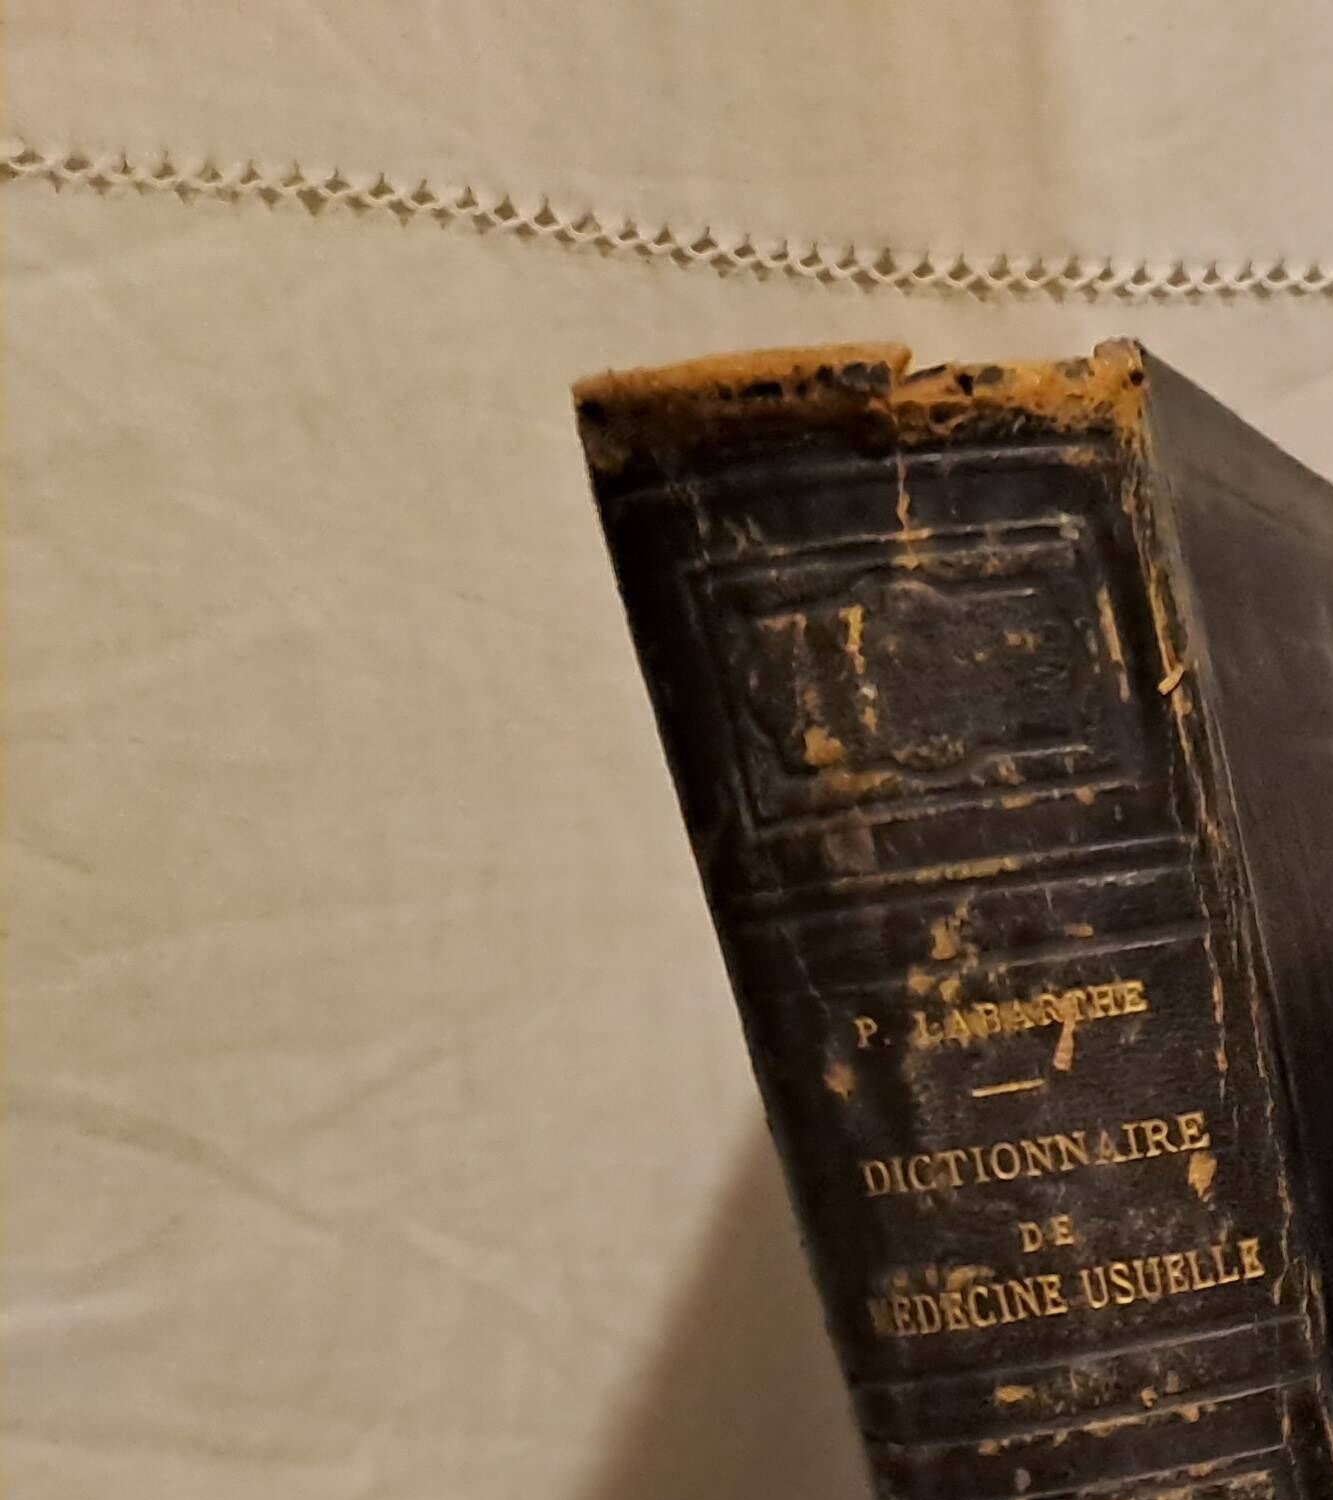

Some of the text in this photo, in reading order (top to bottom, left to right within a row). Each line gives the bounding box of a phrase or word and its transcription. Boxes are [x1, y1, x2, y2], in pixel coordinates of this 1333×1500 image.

[860, 1111, 1211, 1197] DICTIONNAIRE
[1018, 1214, 1076, 1253] DE
[1080, 1238, 1266, 1308] USUELLE
